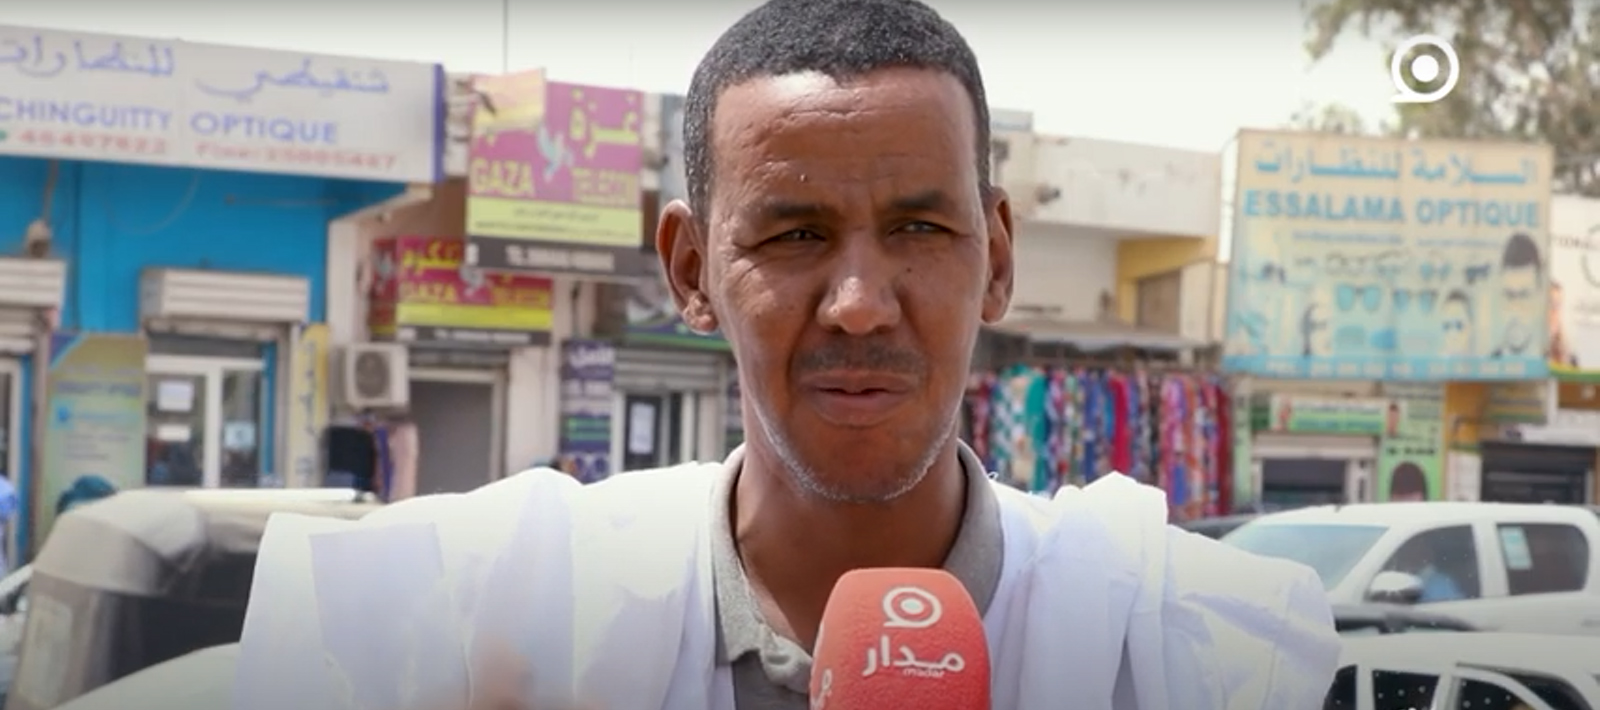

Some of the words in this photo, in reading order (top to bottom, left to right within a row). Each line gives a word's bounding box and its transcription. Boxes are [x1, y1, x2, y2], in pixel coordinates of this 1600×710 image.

[190, 112, 338, 143] OPTIQUE
[471, 159, 535, 196] GAZA
[1244, 190, 1405, 224] ESSALAMA
[1416, 198, 1540, 228] OPTIQUE
[862, 635, 965, 677] مدار
[902, 668, 946, 679] madar
